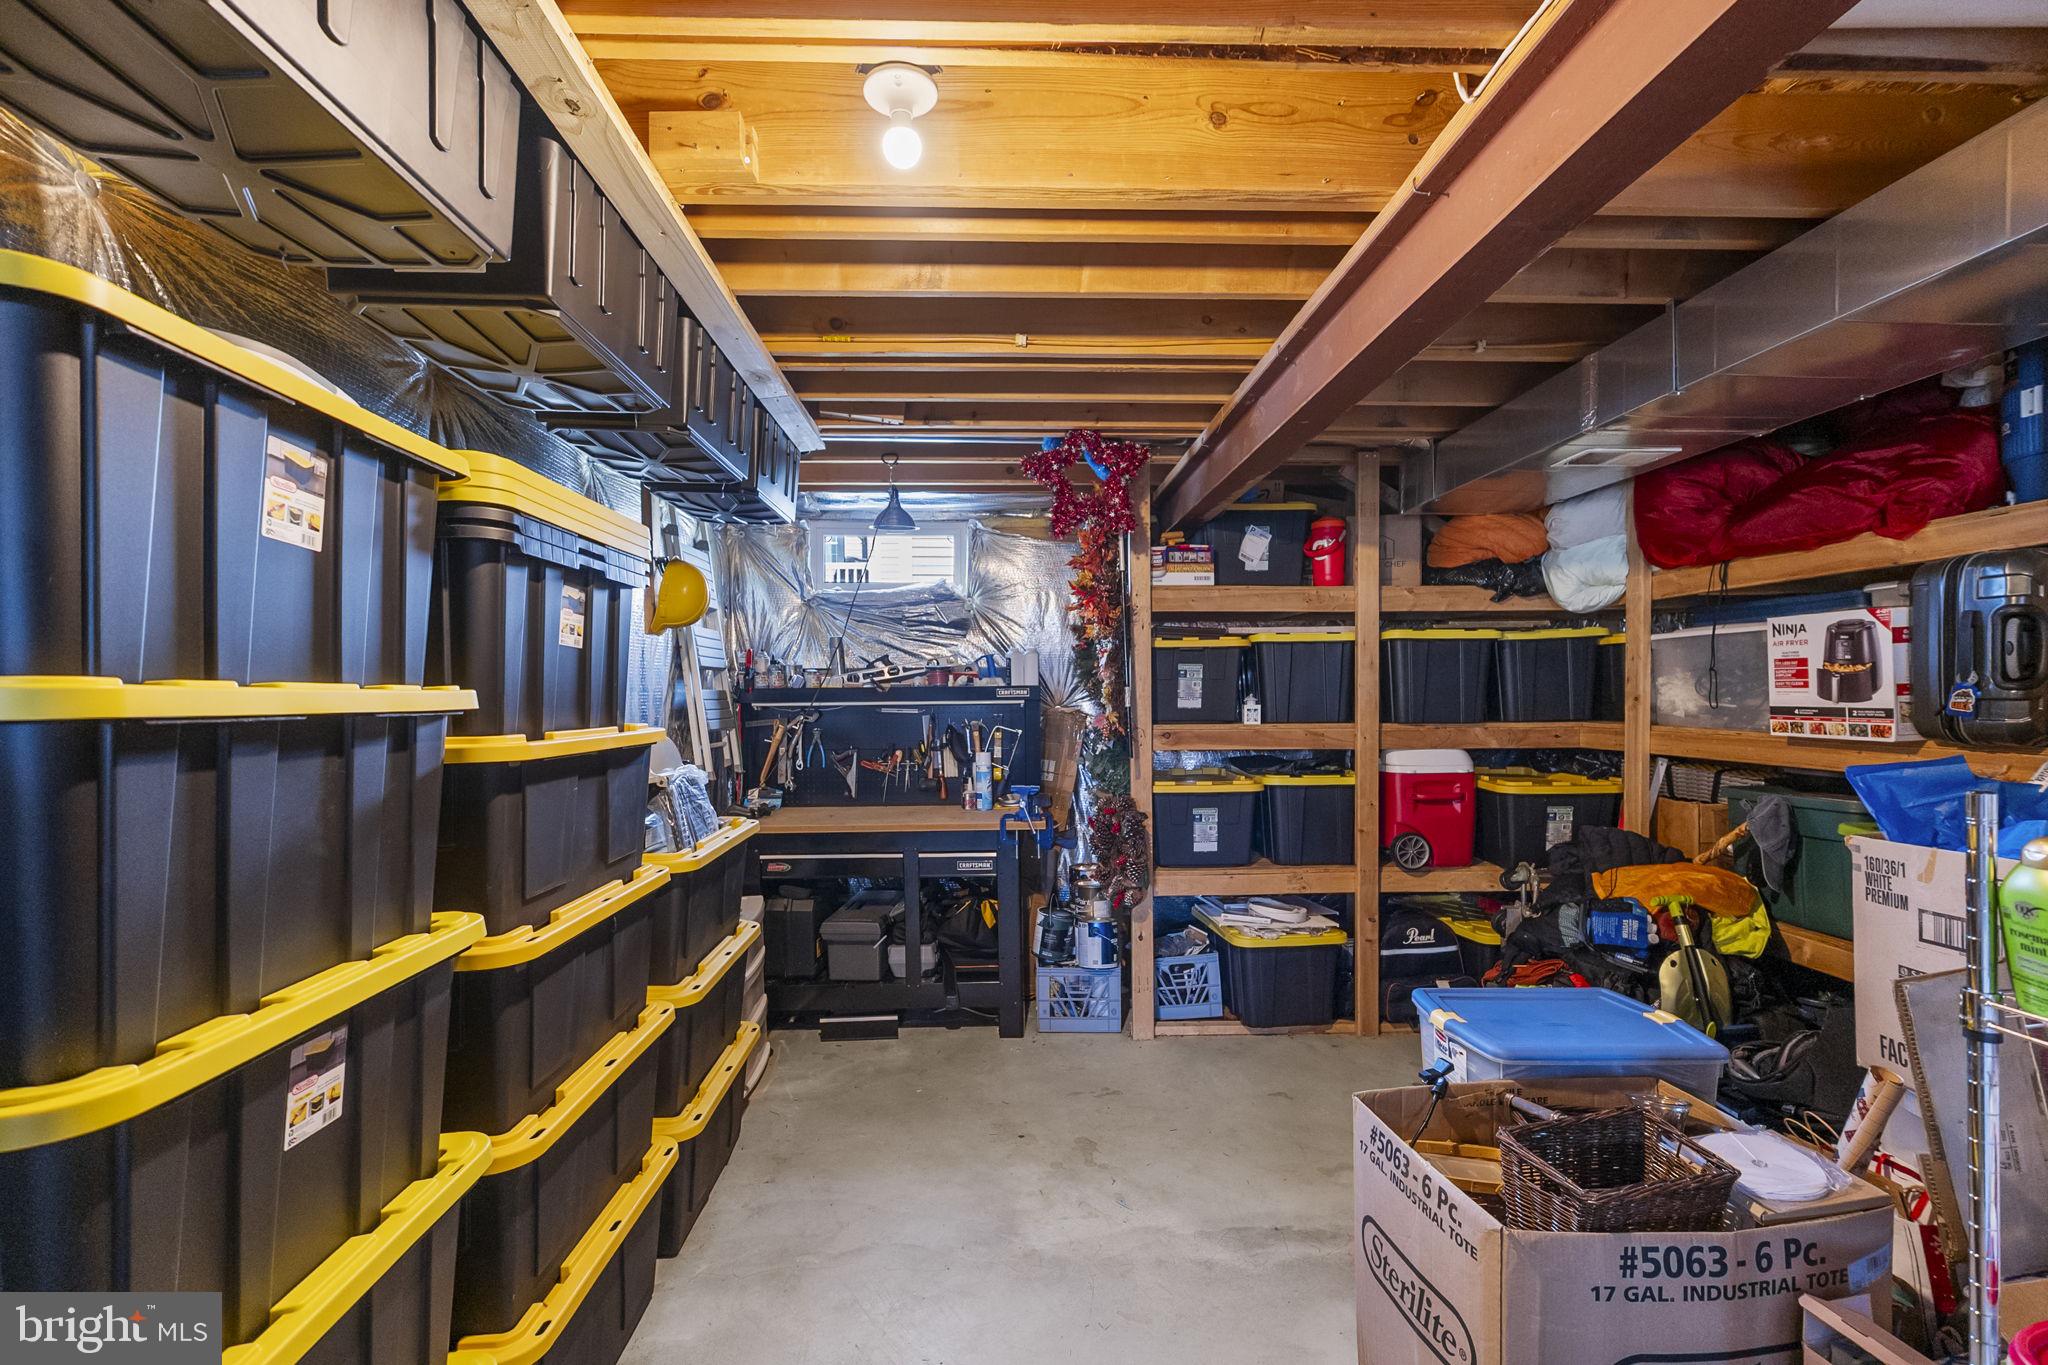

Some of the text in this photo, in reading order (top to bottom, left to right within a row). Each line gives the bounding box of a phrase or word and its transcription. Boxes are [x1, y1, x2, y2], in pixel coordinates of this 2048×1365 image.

[1384, 560, 1408, 568] CHEF
[1772, 623, 1807, 638] NINJA
[1864, 856, 1906, 878] 160/36/1
[1864, 871, 1893, 892] WHITE
[1865, 886, 1909, 911] PREMIUM
[1403, 927, 1436, 945] Pearl
[1369, 1124, 1411, 1179] #5063
[1421, 1173, 1432, 1199] 6
[1359, 1140, 1479, 1262] 17 GAL. INDUSTRIAL TOTE
[1619, 1244, 1729, 1279] #5063
[1754, 1240, 1774, 1274] 6
[1369, 1234, 1458, 1357] Sterilite
[1590, 1266, 1849, 1303] 17 GAL. INDUSTRIAL TOTE
